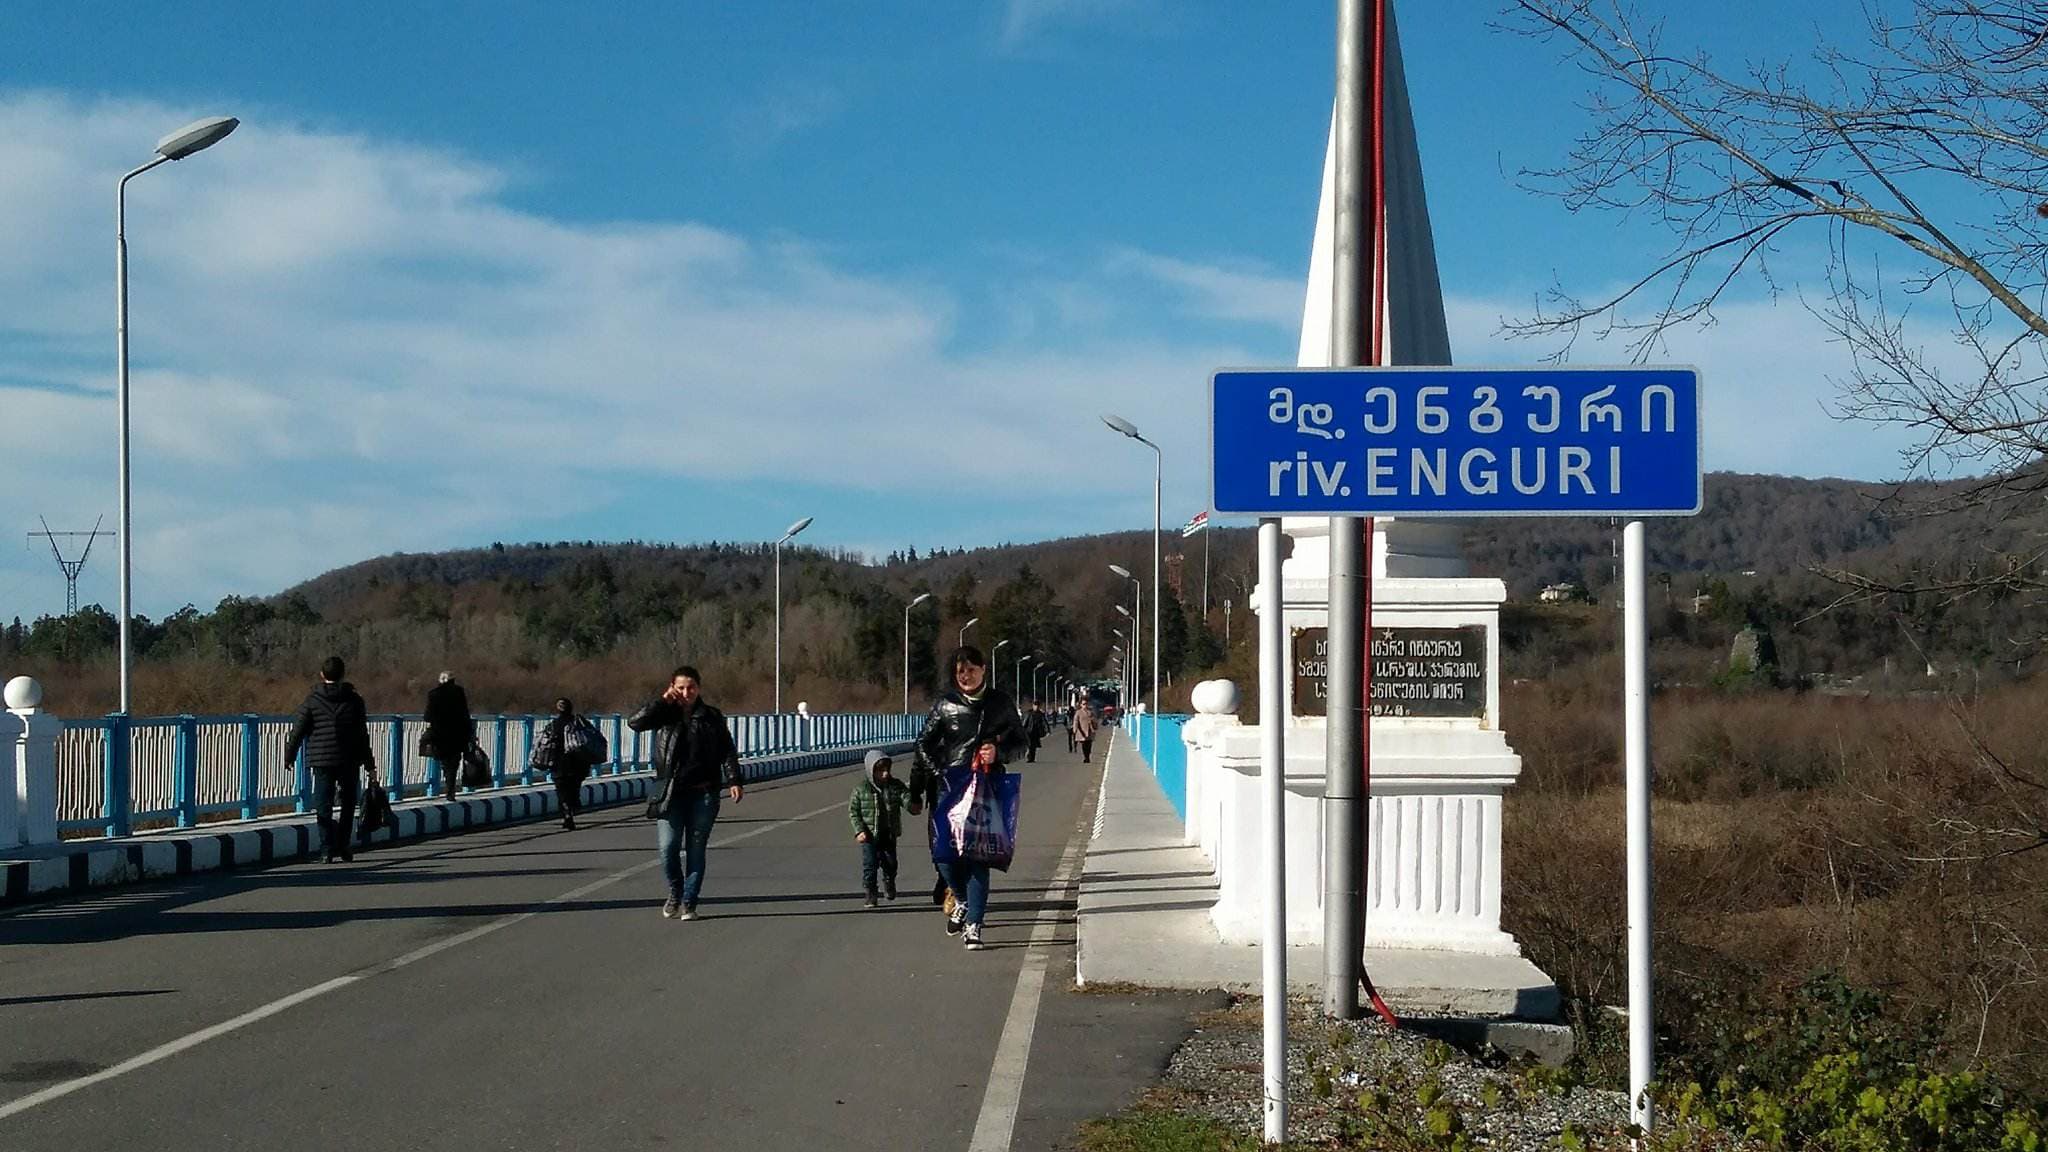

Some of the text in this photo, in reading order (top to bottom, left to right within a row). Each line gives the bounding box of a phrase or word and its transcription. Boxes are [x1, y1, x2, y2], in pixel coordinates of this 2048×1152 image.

[1268, 384, 1676, 440] მდ. ენგური
[1269, 446, 1621, 497] riv. ENGURI
